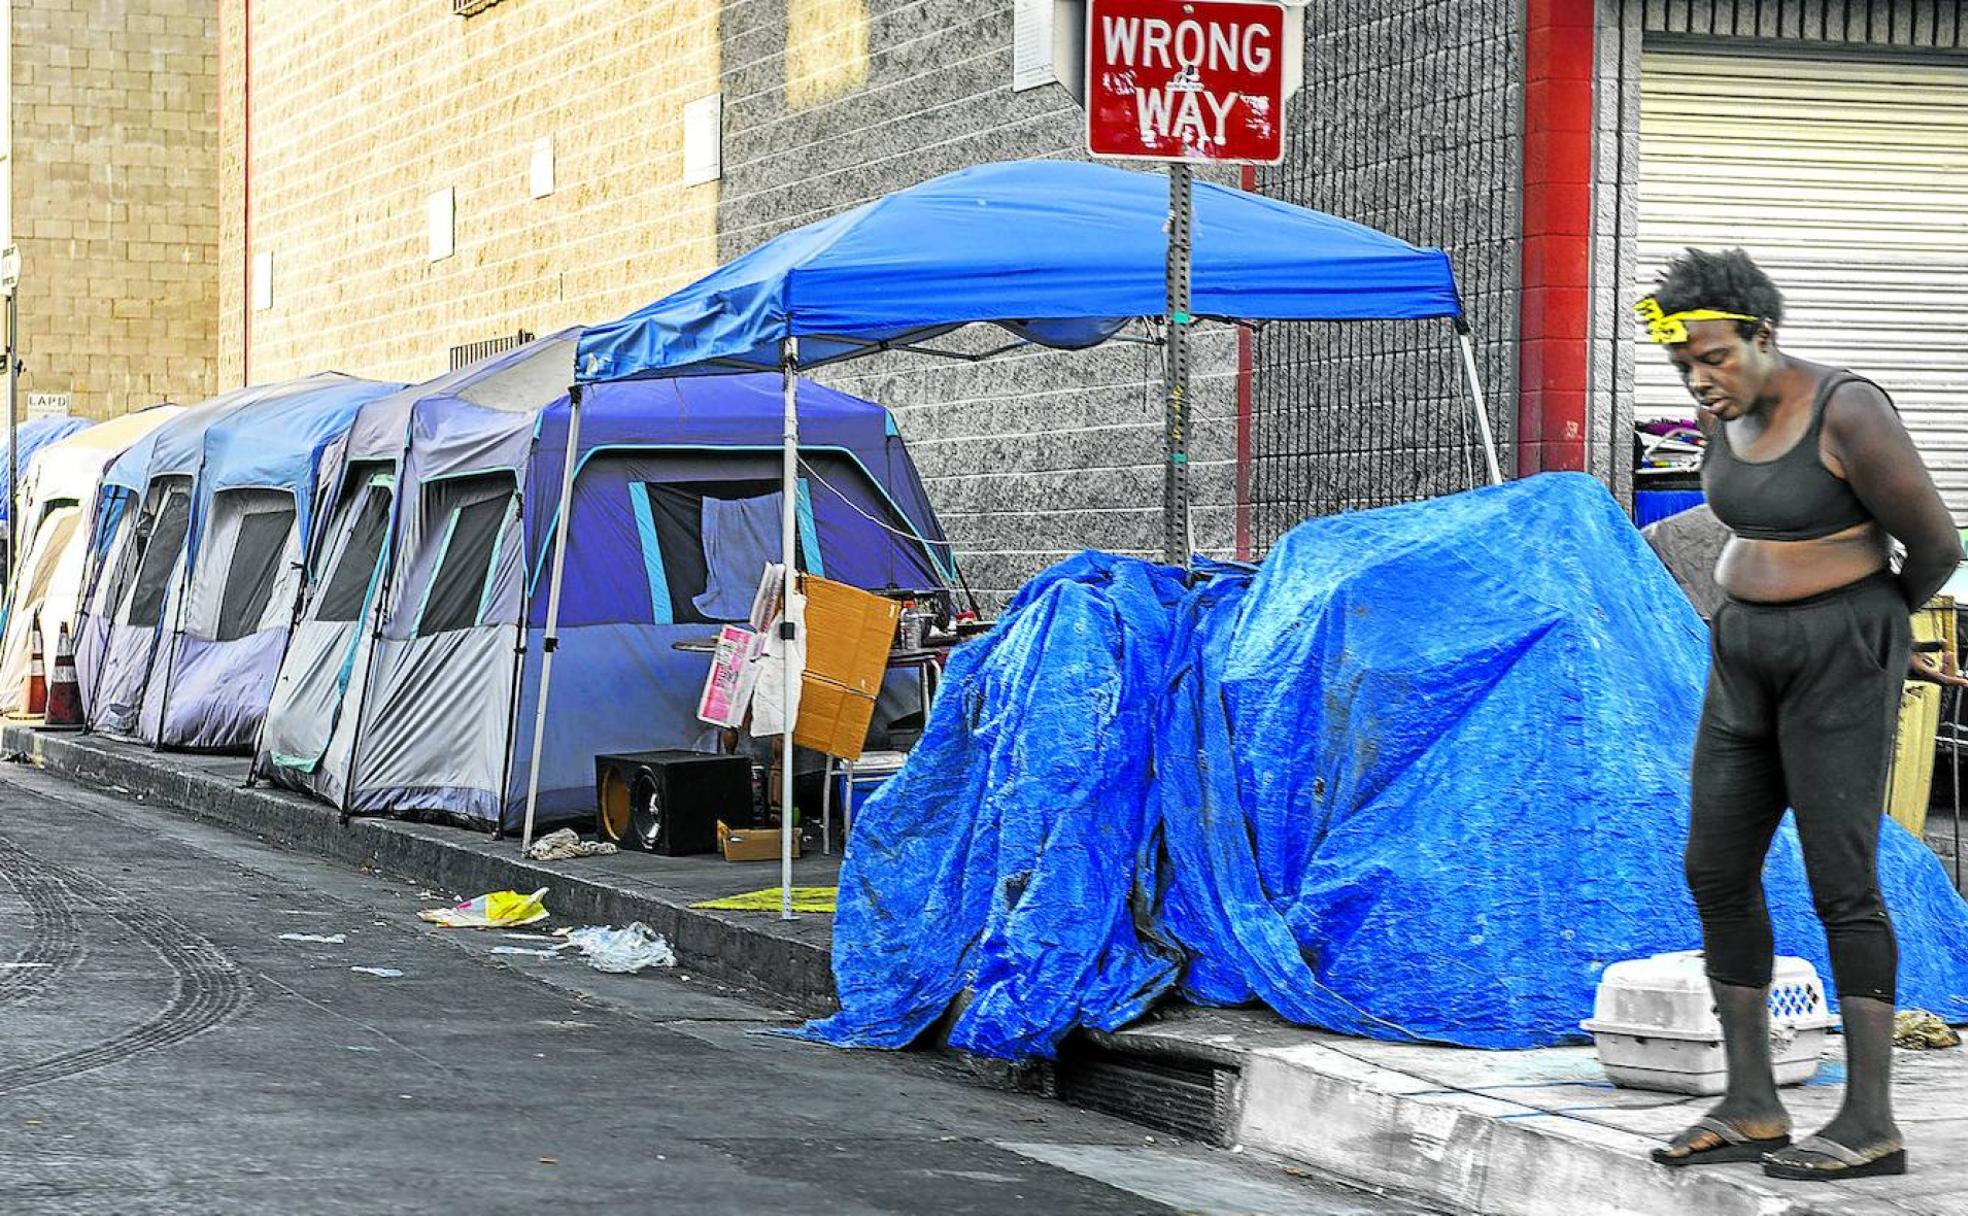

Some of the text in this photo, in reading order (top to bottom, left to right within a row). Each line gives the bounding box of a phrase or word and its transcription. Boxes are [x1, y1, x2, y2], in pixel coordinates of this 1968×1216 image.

[1102, 16, 1272, 73] WRONG
[1136, 86, 1239, 145] WAY
[29, 395, 66, 406] LAPD
